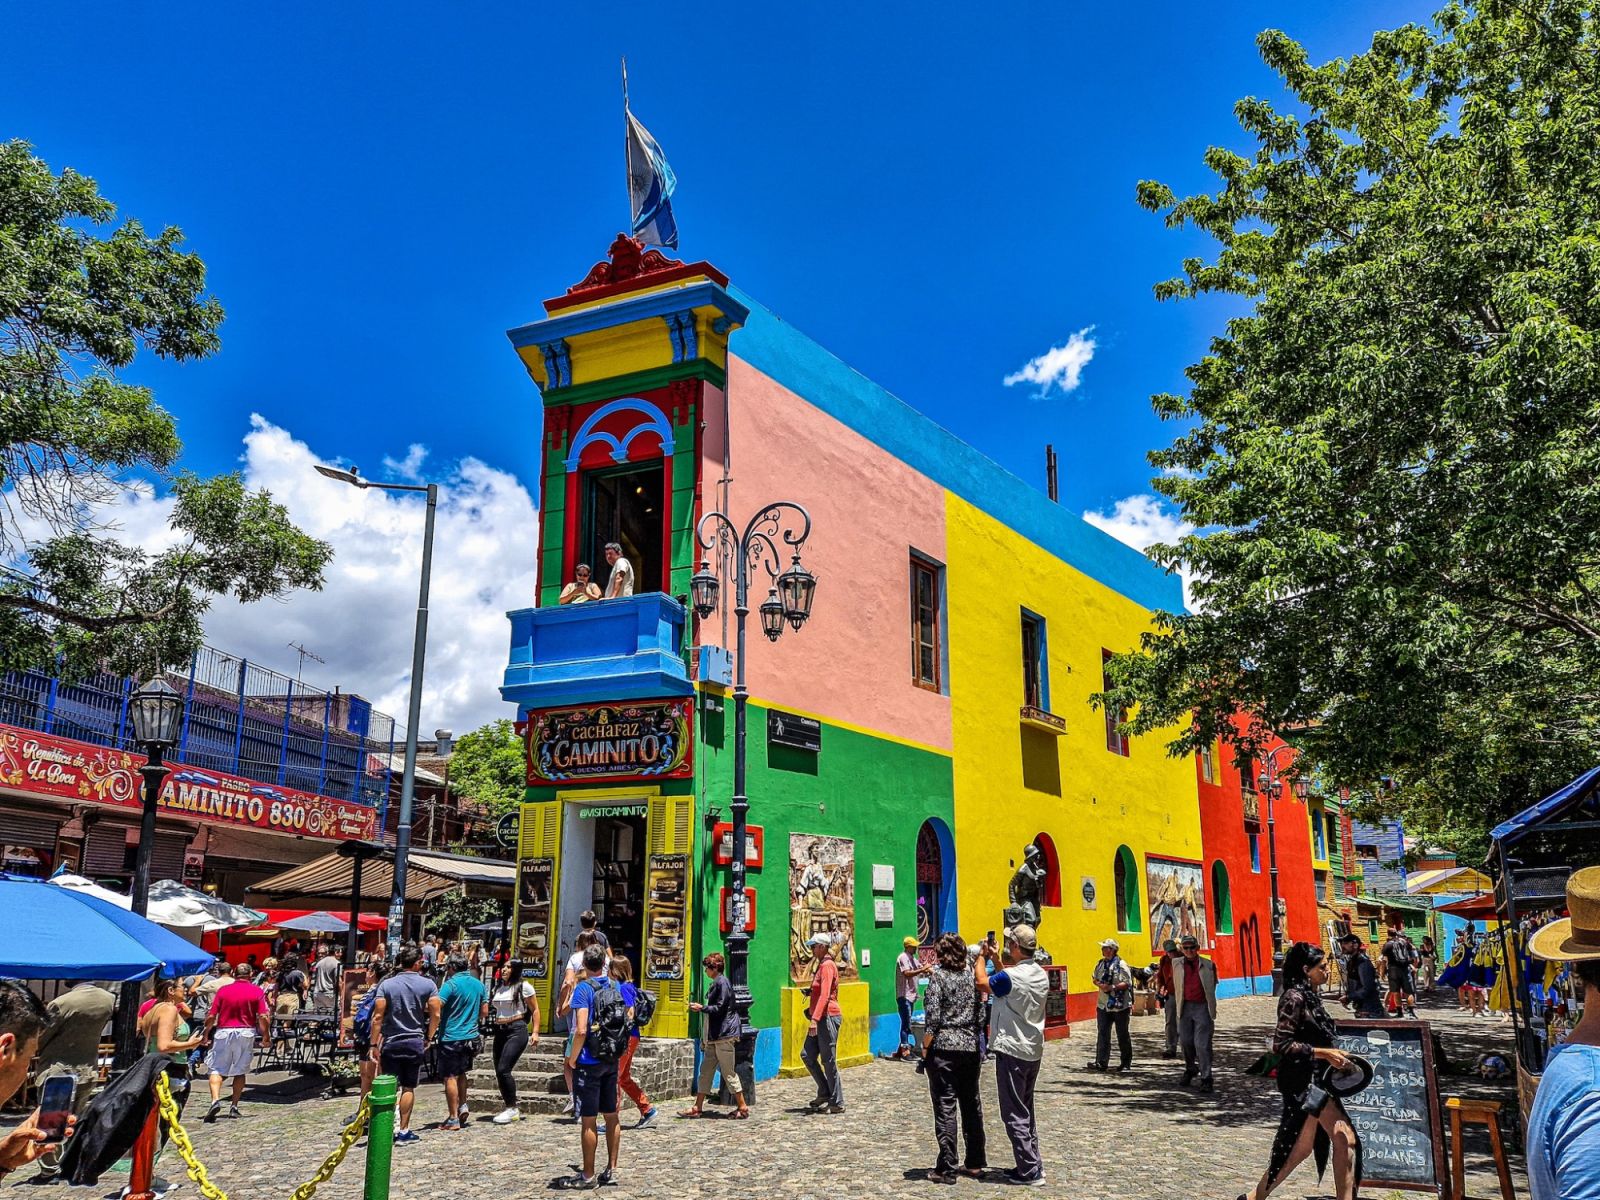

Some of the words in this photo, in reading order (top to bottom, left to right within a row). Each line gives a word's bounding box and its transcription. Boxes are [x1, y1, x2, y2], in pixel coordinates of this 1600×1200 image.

[554, 735, 660, 768] CAMINITO
[28, 760, 46, 781] La
[47, 763, 77, 785] Boca
[577, 765, 606, 774] BUENOS
[609, 764, 632, 773] AIRES
[269, 801, 305, 829] 830
[579, 805, 649, 819] @VISITCAMINITO
[522, 865, 551, 873] ALFAJOR
[651, 861, 684, 869] ALFAJOR
[1370, 1132, 1417, 1147] REALES
